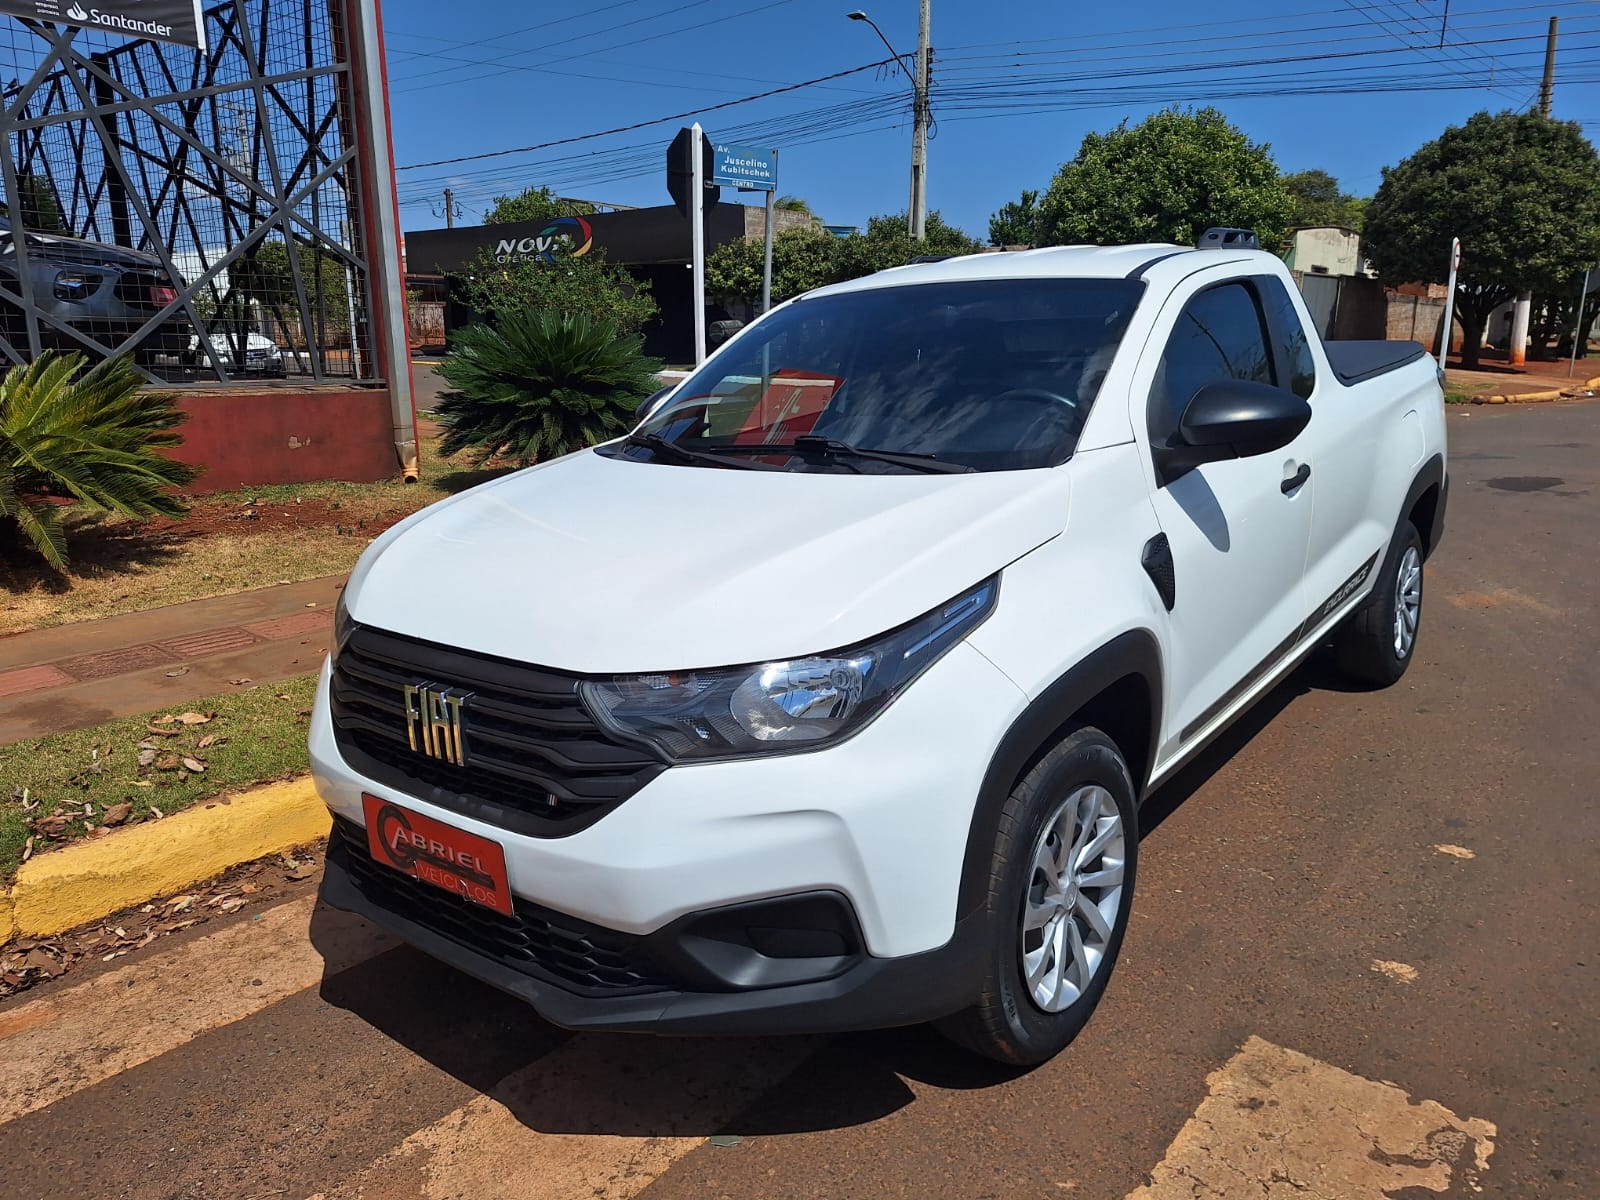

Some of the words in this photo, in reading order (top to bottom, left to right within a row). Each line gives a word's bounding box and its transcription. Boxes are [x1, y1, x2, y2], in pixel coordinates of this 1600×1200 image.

[90, 8, 173, 37] Santander
[717, 145, 730, 153] Av.
[724, 155, 768, 169] Juscelino
[721, 165, 770, 177] Kubitschek
[731, 180, 754, 188] CENTRO
[404, 684, 464, 767] FIAT
